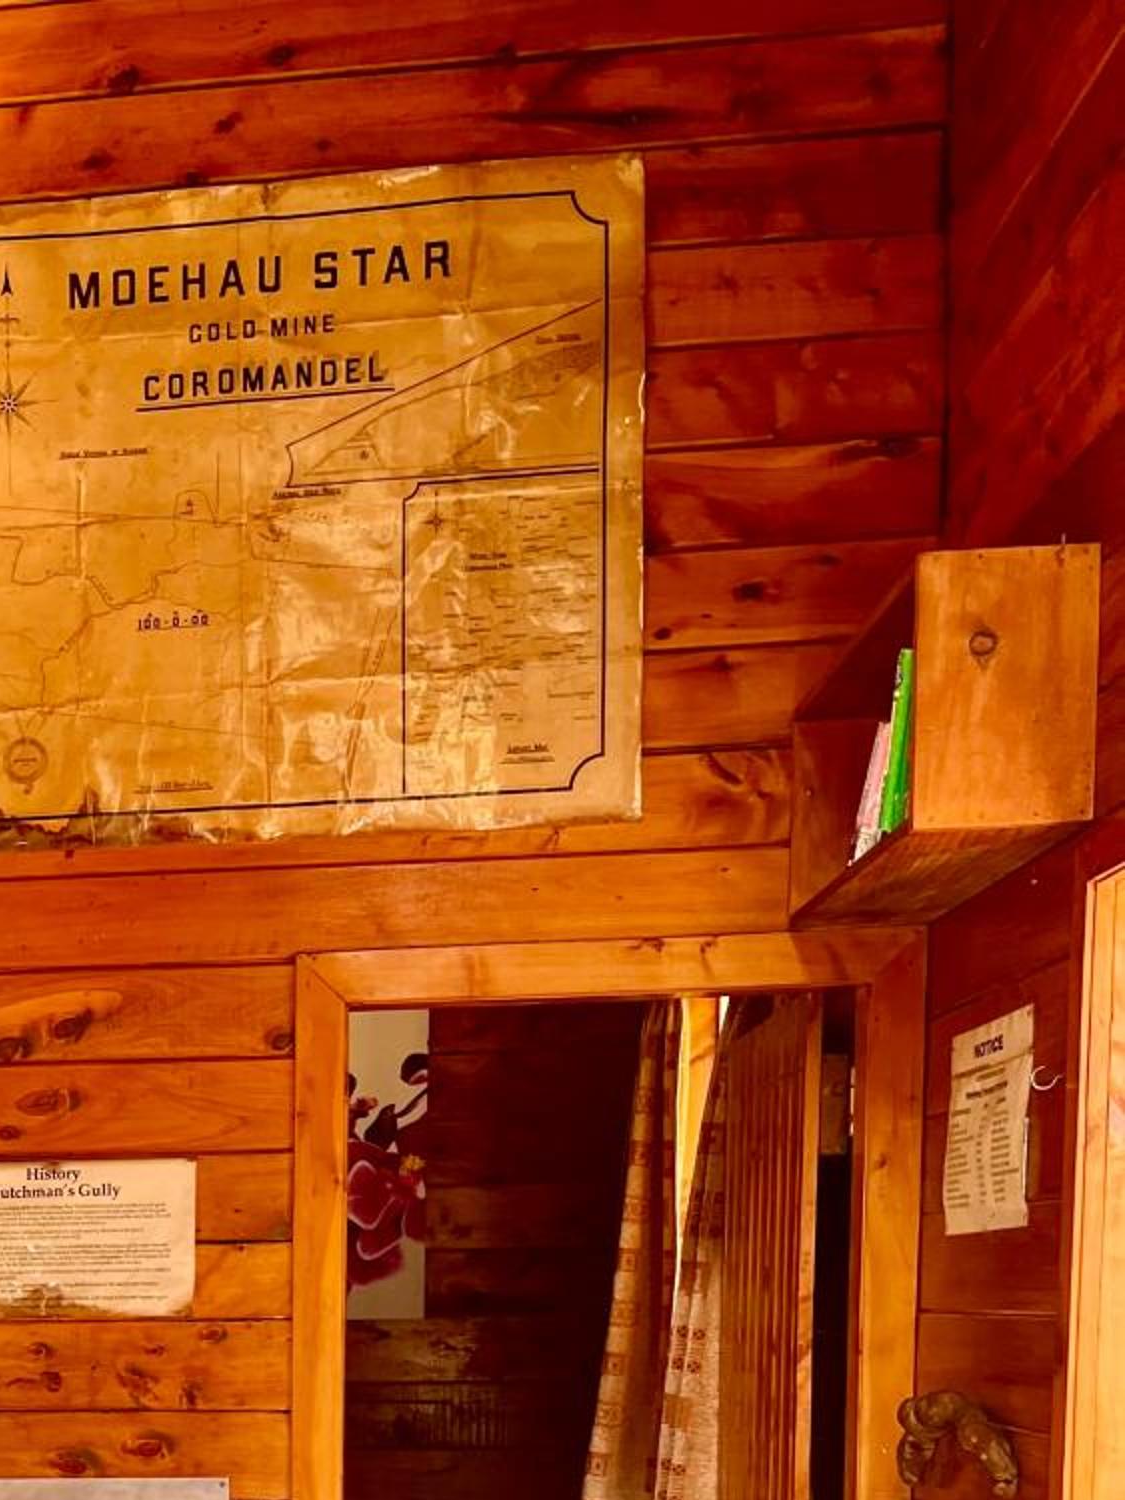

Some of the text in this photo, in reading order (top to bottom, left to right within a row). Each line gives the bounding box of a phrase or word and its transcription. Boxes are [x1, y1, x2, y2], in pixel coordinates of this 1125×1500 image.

[68, 240, 451, 310] MOEHAU STAR
[188, 313, 336, 344] GOLD MINE
[143, 355, 385, 401] COROMANDEL
[974, 1034, 1004, 1058] NOTICE
[26, 1166, 81, 1183] History
[78, 1183, 121, 1200] Gully
